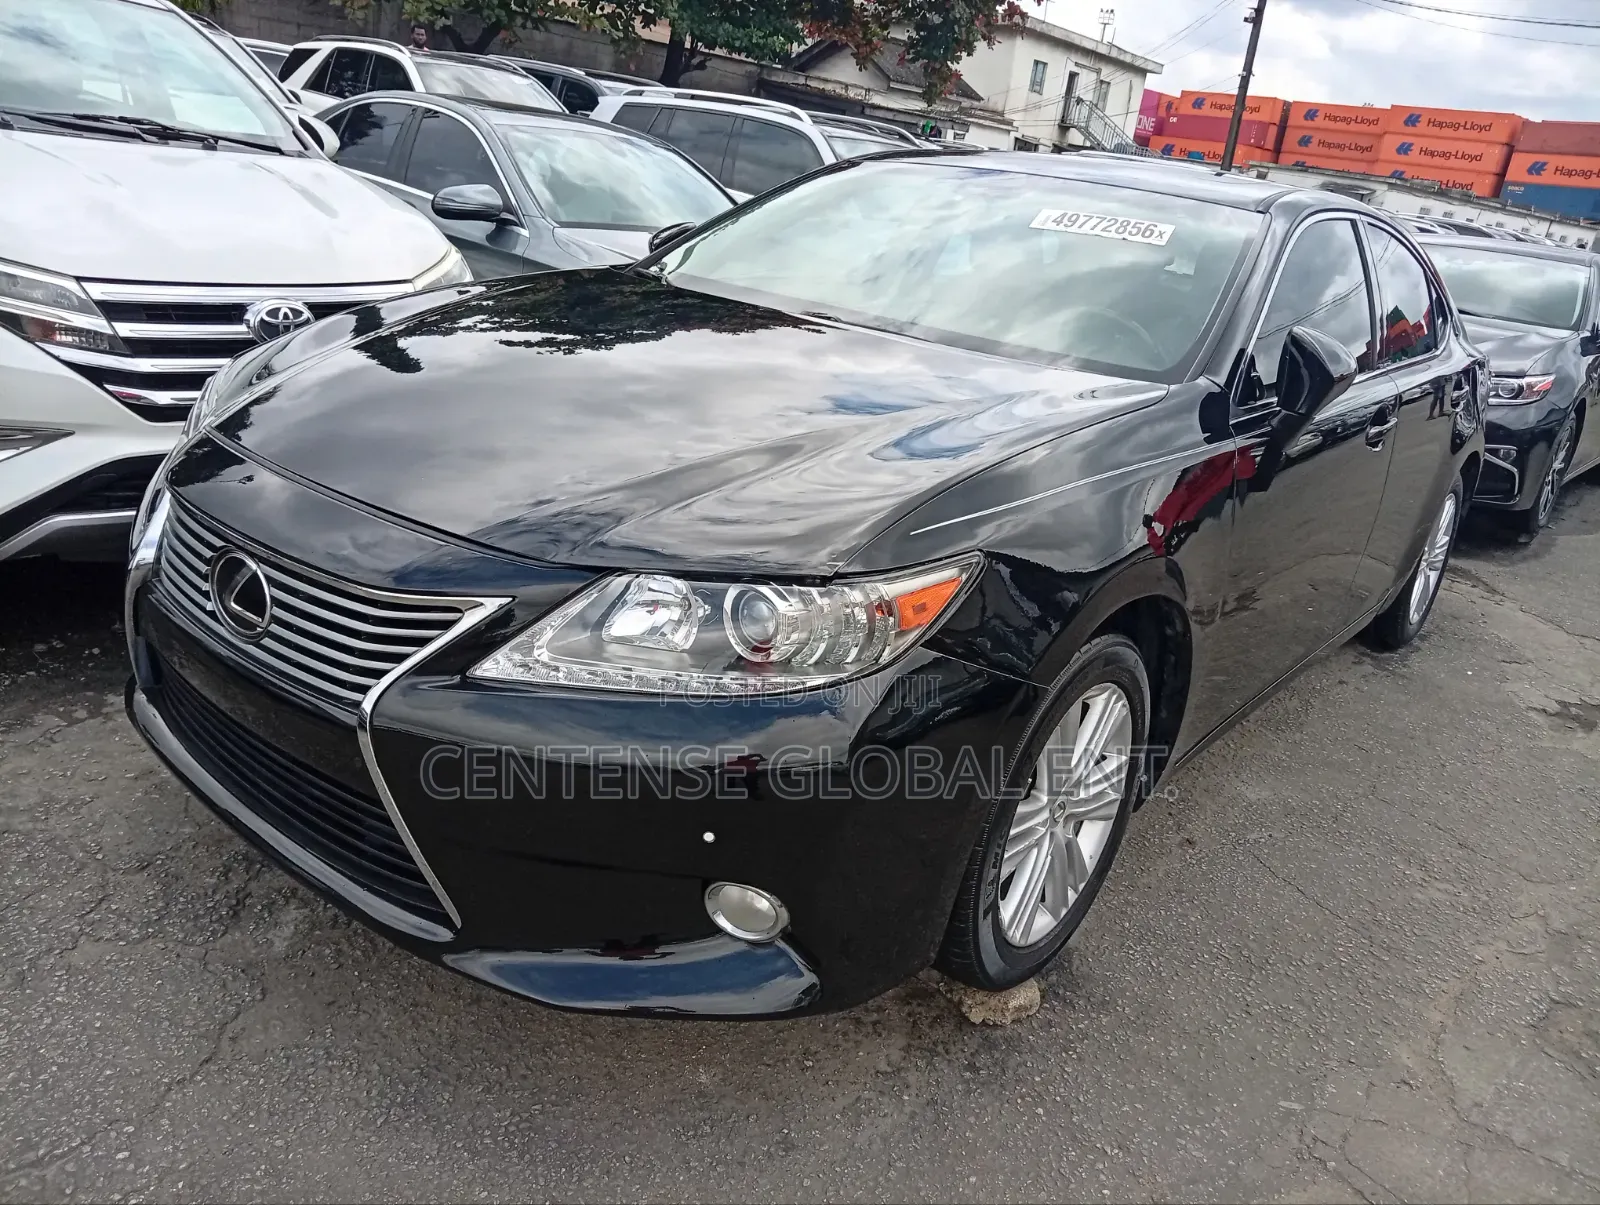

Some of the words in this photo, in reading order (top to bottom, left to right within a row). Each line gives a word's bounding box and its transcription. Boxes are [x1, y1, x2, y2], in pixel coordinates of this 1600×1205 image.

[1209, 101, 1261, 114] Hapagoyd
[1136, 114, 1156, 131] ONE
[1323, 112, 1380, 126] Hapag-Lloyd
[1427, 118, 1493, 133] Hapag-Lloyd
[1317, 139, 1374, 153] Hapag-Lloyd
[1179, 148, 1223, 162] Hg-Lloy
[1418, 147, 1484, 163] Hapag-Lloyd
